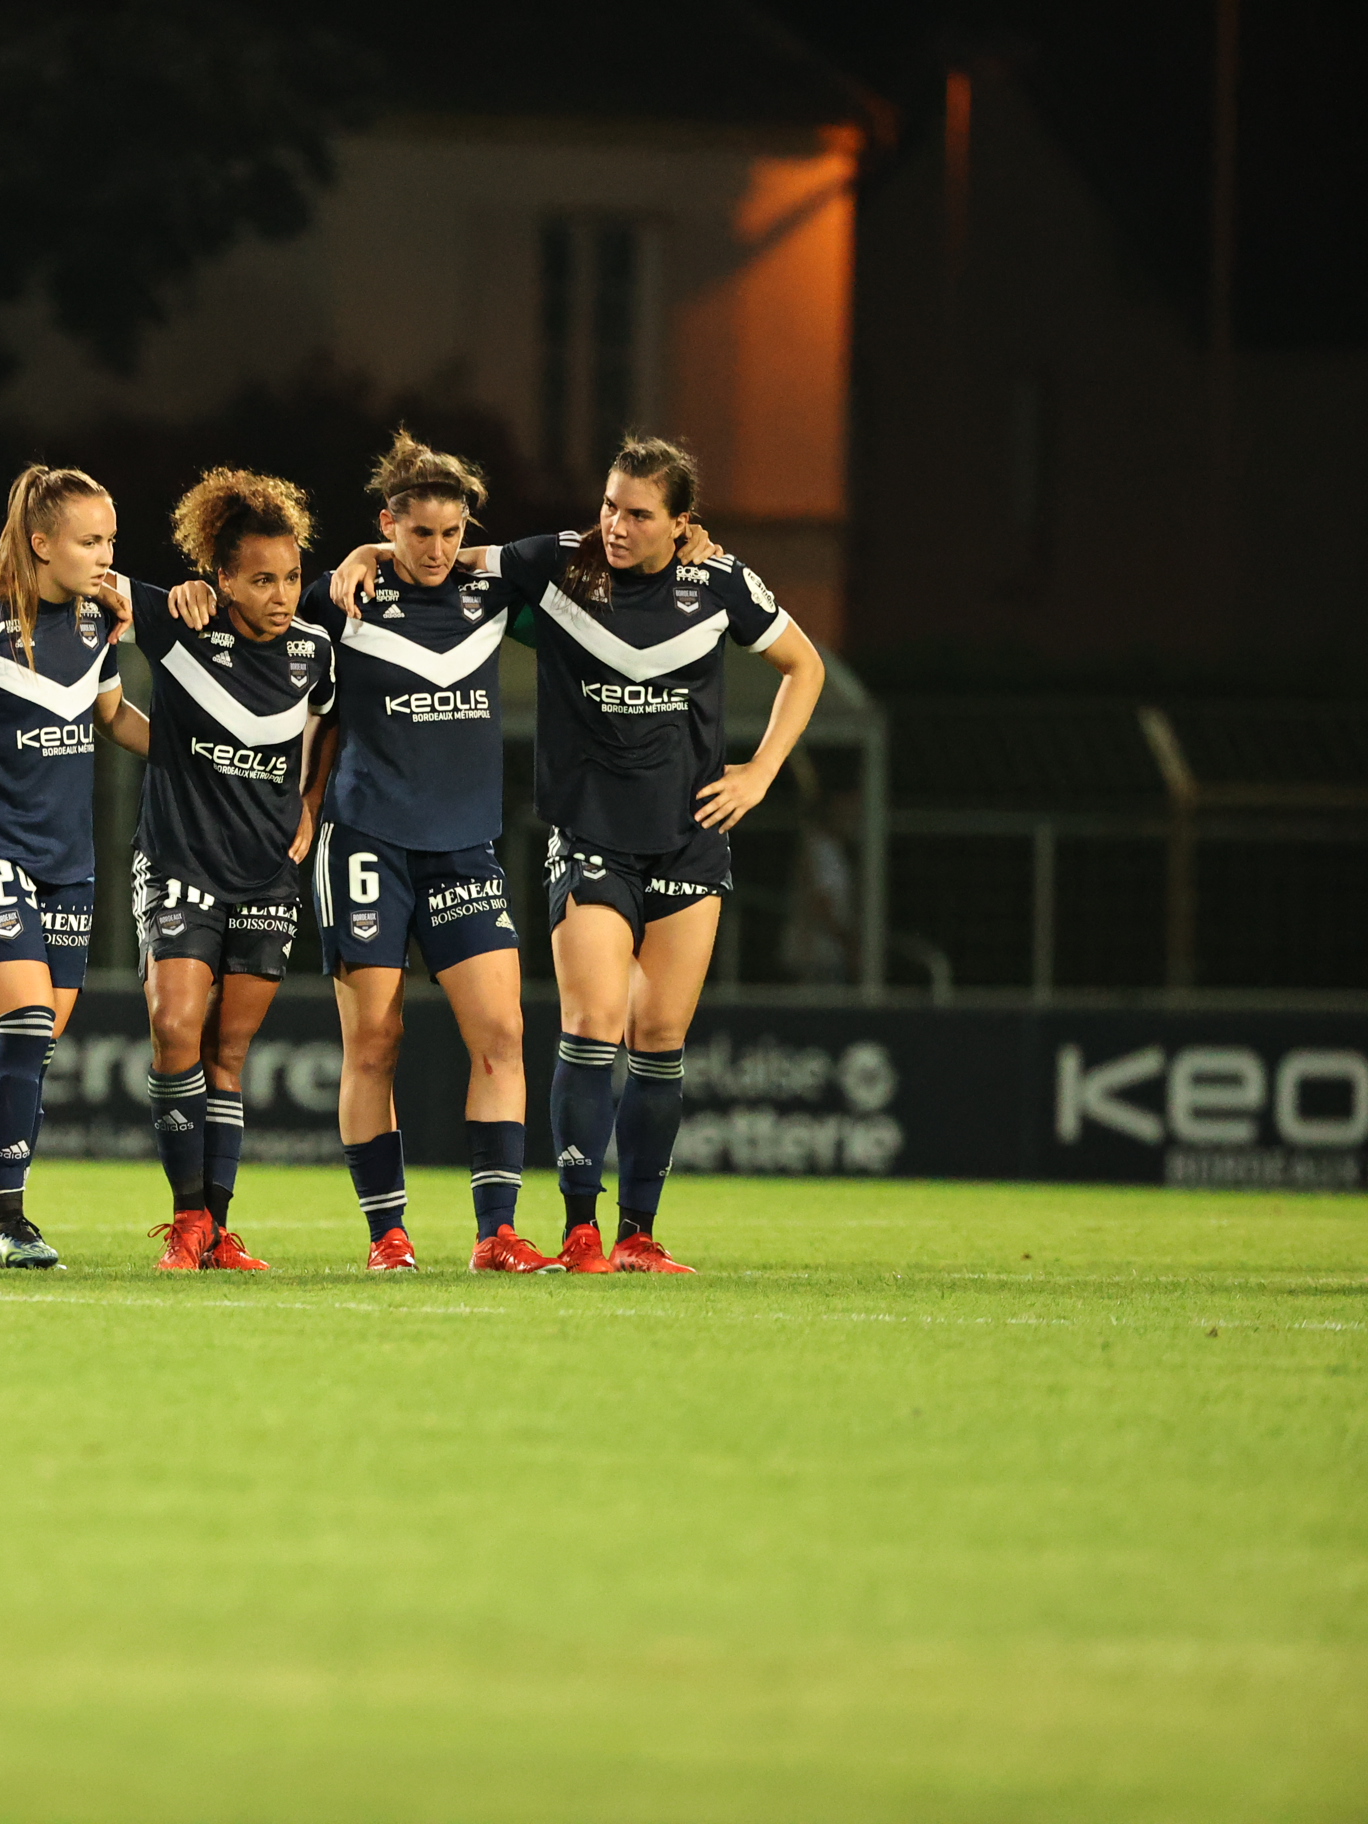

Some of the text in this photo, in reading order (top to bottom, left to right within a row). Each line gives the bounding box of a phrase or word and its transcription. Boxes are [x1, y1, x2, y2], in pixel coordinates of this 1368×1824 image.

[601, 702, 689, 714] BORDEAUX MÉTROPOLE
[412, 709, 491, 723] BORDEAUX MÉTROPOLE
[42, 745, 77, 757] BORDEAUX
[349, 852, 380, 904] 6
[428, 879, 503, 912] MENEAU
[431, 901, 489, 927] BOISSONS
[490, 898, 507, 909] BIO
[229, 918, 288, 934] BOISSONS
[154, 1122, 194, 1132] adidas
